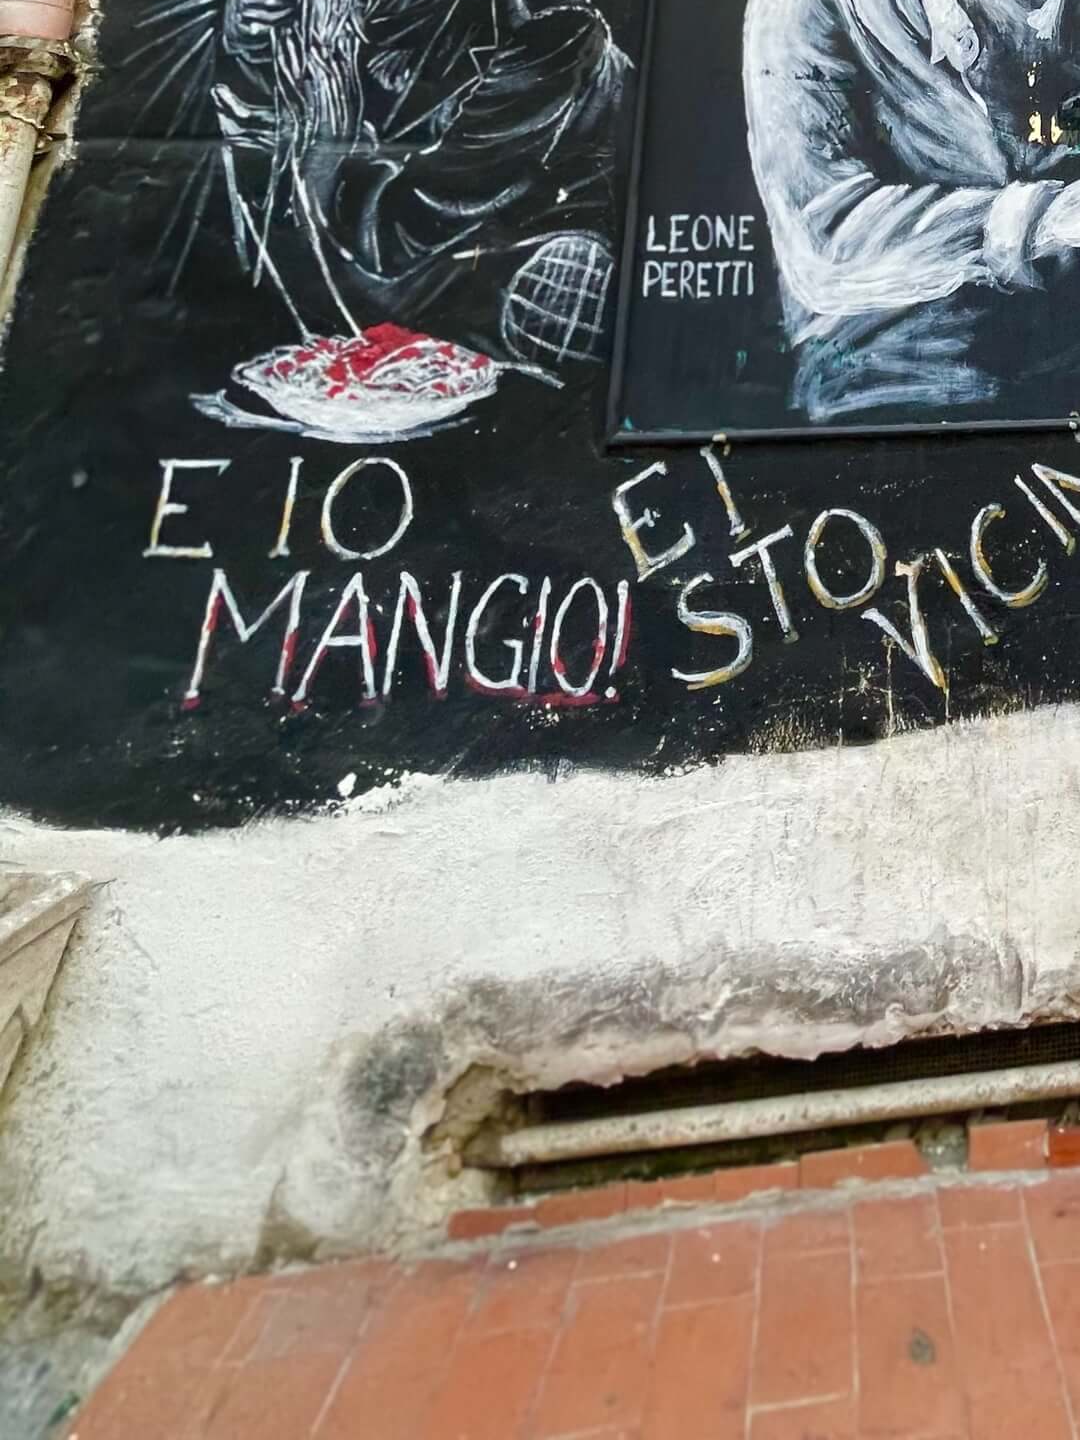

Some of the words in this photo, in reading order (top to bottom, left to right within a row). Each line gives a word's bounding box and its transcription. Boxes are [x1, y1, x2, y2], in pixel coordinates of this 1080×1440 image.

[645, 213, 756, 254] LEONE
[642, 260, 755, 300] PERETTI
[181, 568, 632, 709] MANGIO!
